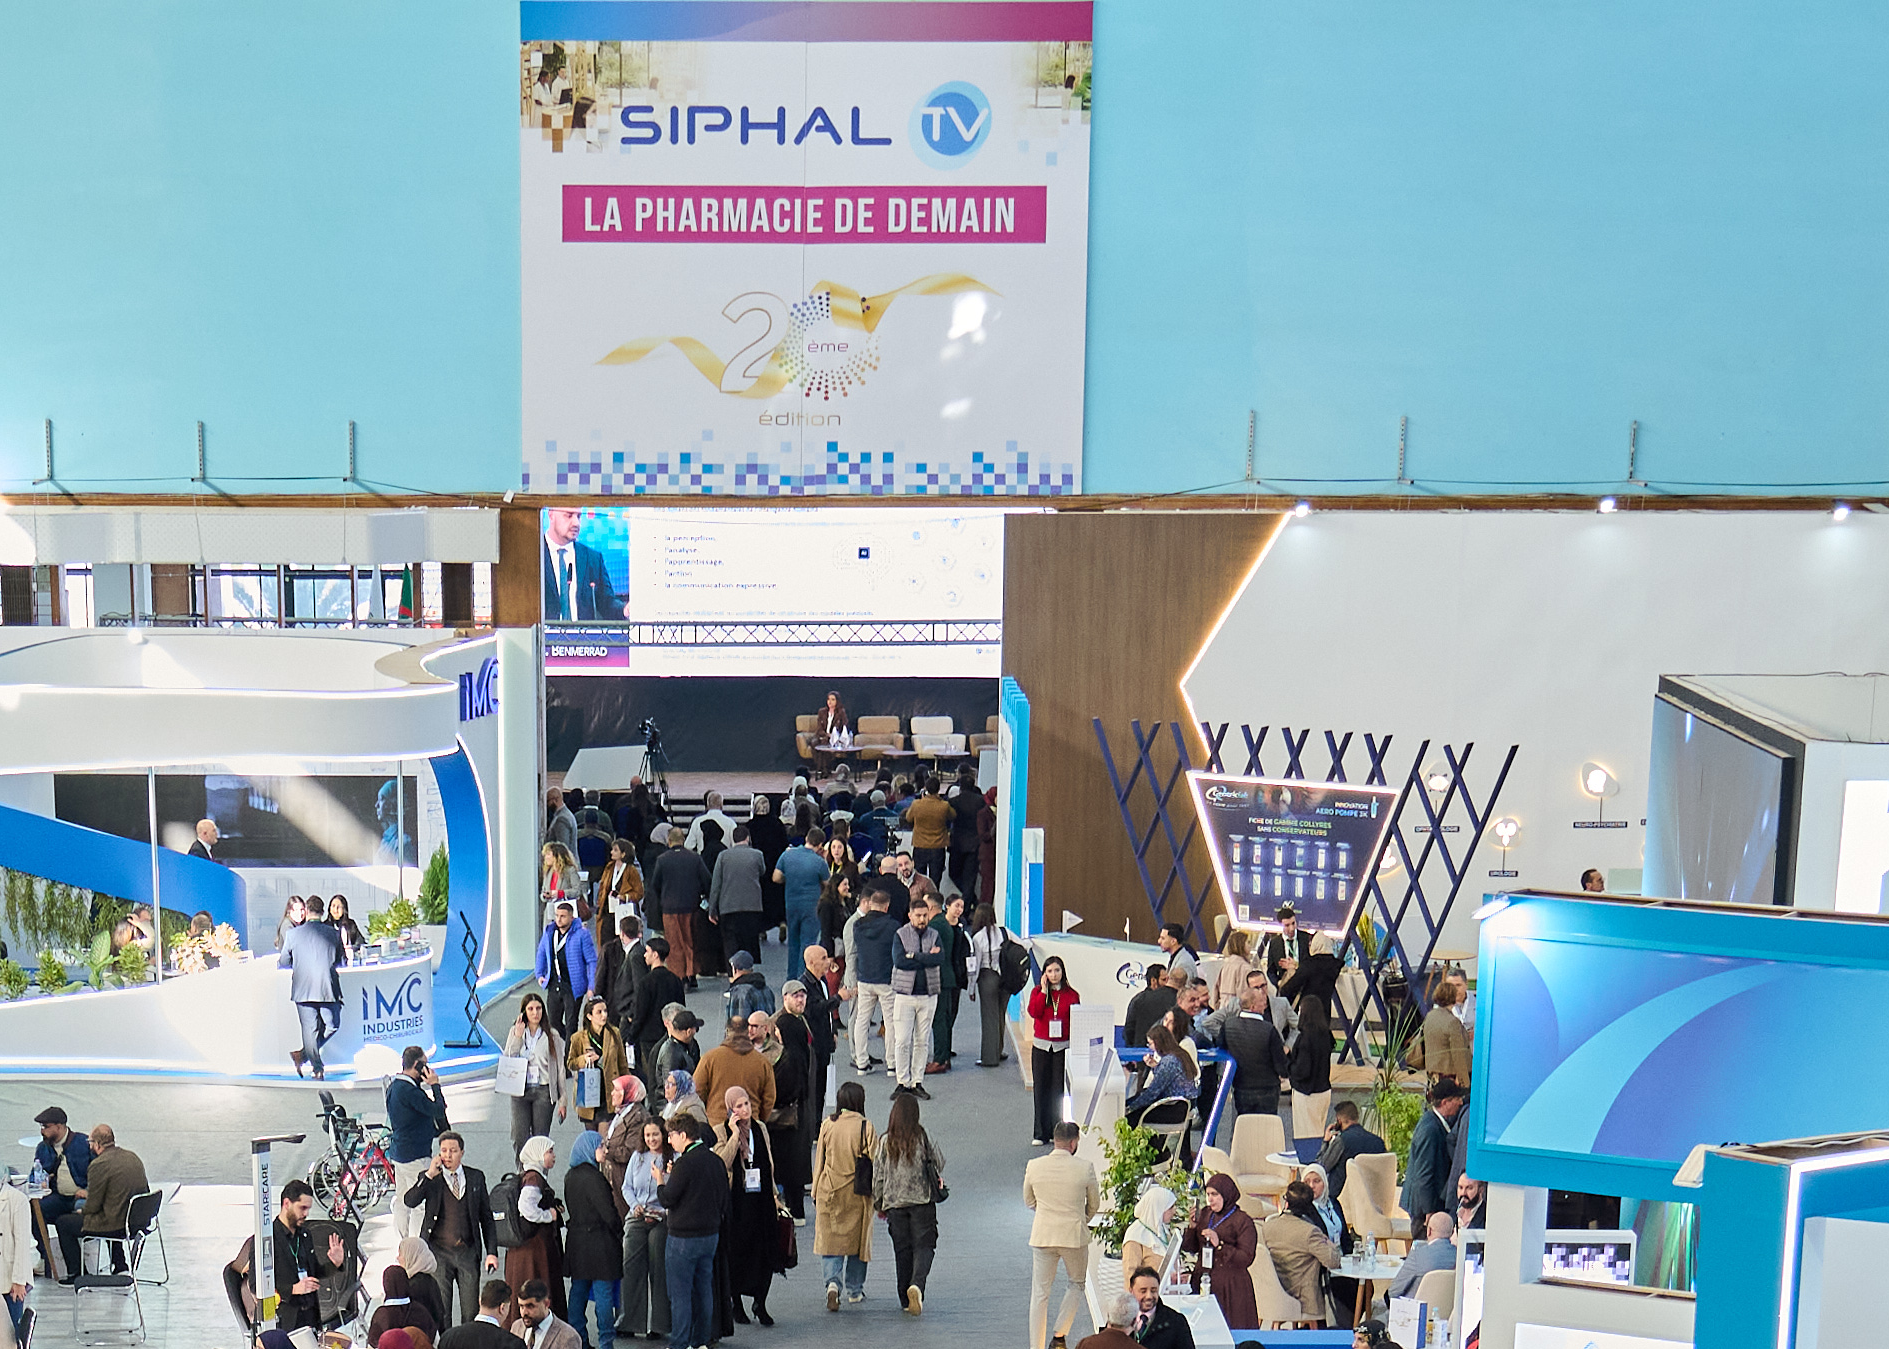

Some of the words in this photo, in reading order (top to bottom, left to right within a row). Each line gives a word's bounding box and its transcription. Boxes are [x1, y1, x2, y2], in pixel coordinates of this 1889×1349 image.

[620, 105, 892, 146] SIPHAL
[921, 106, 990, 141] TV
[584, 198, 622, 232] LA
[634, 197, 823, 234] PHARMACIE
[834, 198, 875, 234] DE
[887, 198, 1015, 233] DEMAIN
[808, 338, 849, 353] ème
[759, 409, 841, 427] édition
[458, 656, 499, 722] IMC
[362, 972, 423, 1020] IMC
[363, 1015, 424, 1035] INDUSTRIES
